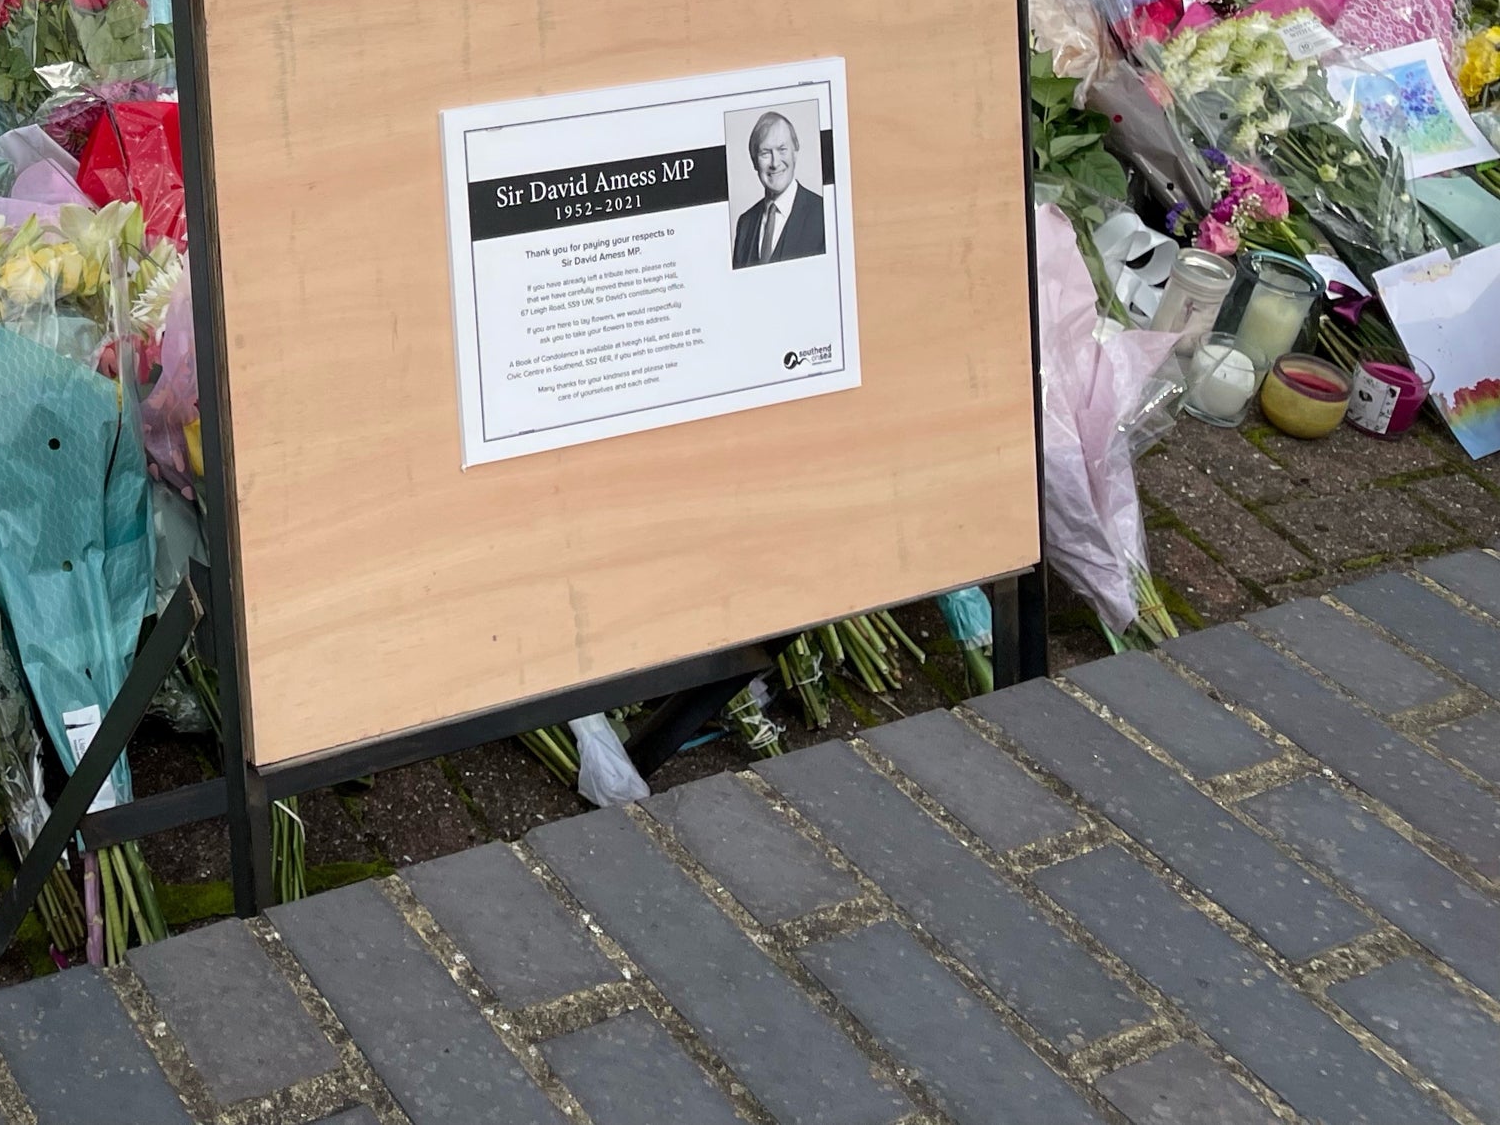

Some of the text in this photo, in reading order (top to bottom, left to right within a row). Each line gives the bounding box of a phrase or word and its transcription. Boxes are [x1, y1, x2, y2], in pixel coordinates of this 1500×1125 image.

[496, 158, 693, 207] Sir David Amess MP
[525, 247, 550, 258] Thank
[552, 246, 567, 256] you
[569, 243, 580, 251] for
[582, 239, 610, 251] paying
[612, 236, 629, 246] your
[632, 230, 664, 241] respects
[561, 246, 640, 267] Sir David Amess MP.
[532, 284, 544, 292] you
[563, 276, 586, 285] already
[604, 270, 623, 278] tribute
[641, 264, 661, 273] please
[567, 286, 594, 296] carefully
[595, 283, 616, 291] moved
[530, 306, 547, 315] Leigh
[567, 300, 580, 308] SS9
[627, 307, 645, 315] would
[552, 335, 564, 343] you
[587, 328, 601, 336] your
[602, 323, 624, 331] flowers
[541, 350, 578, 361] Condolence
[799, 344, 831, 356] southend
[506, 372, 521, 380] Civic
[523, 368, 544, 377] Centre
[654, 342, 684, 352] contribute
[556, 381, 576, 389] thanks
[588, 376, 601, 385] your
[603, 371, 629, 379] kindness
[631, 367, 642, 375] and
[644, 364, 663, 373] please
[580, 385, 613, 397] yourselves
[627, 379, 642, 387] each
